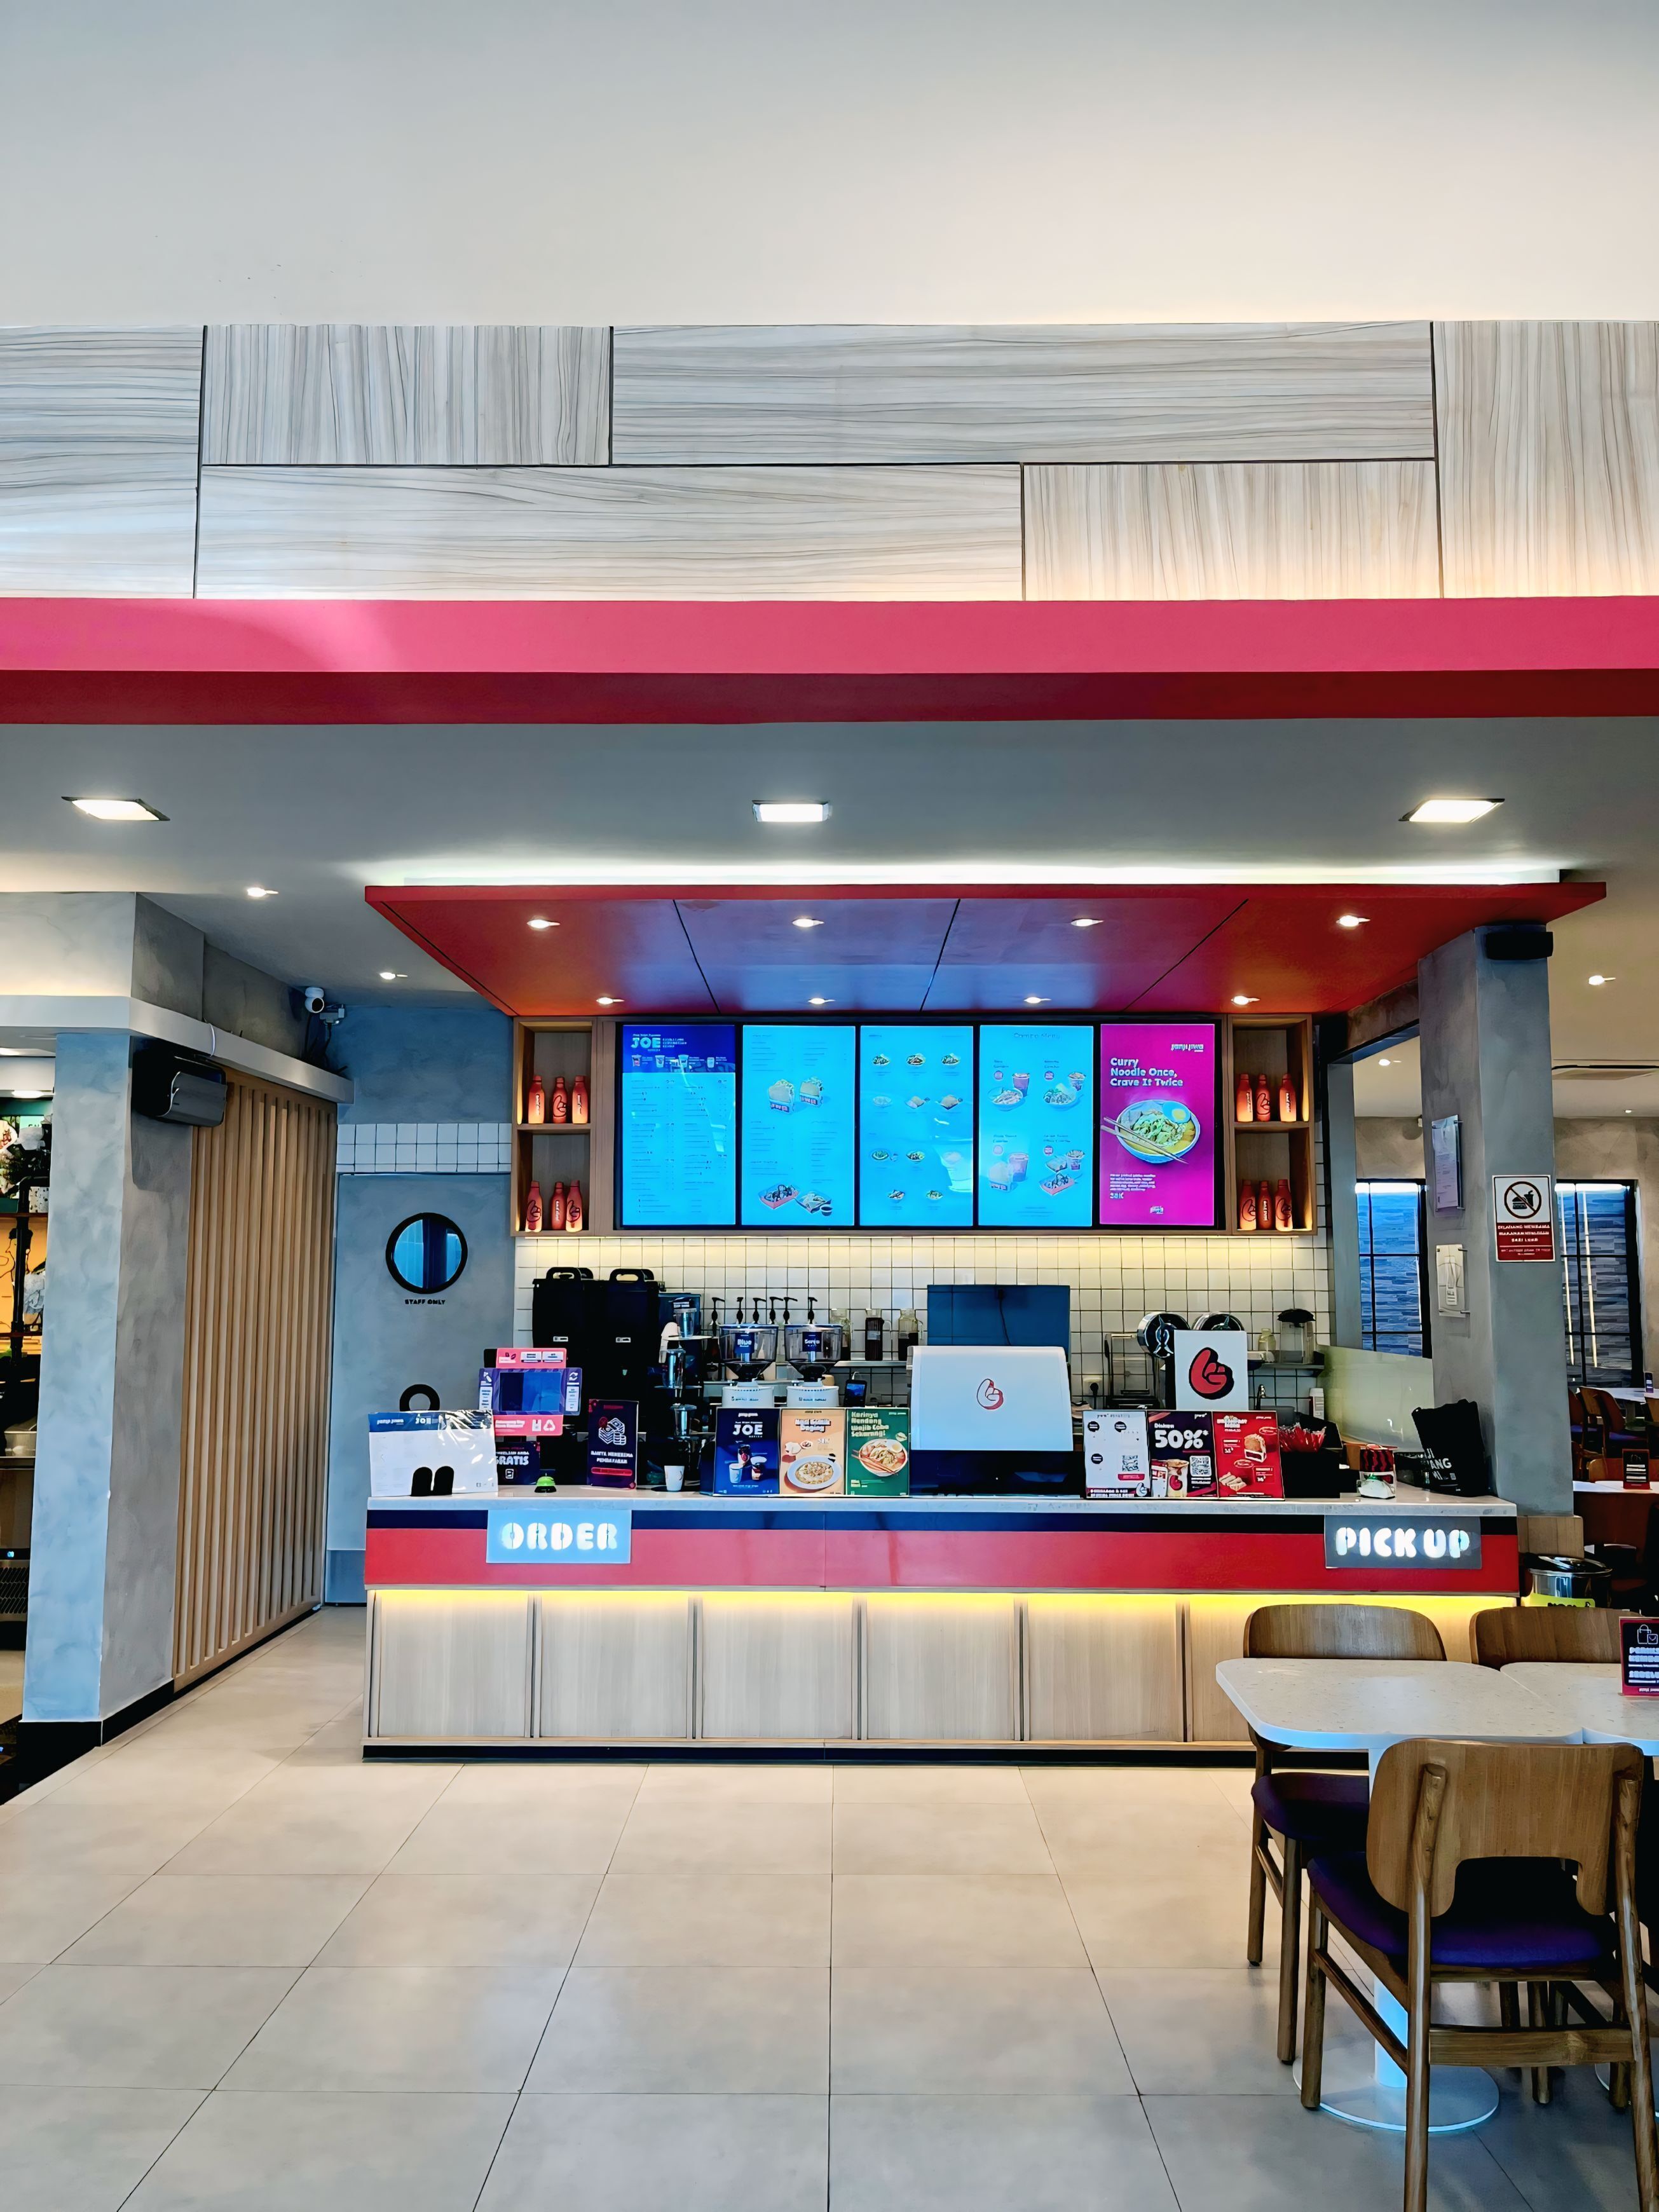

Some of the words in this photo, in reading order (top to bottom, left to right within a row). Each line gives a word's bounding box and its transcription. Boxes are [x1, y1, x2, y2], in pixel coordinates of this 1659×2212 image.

[631, 1037, 661, 1048] JOE
[1110, 1058, 1138, 1068] Curry
[1110, 1068, 1146, 1076] Noodle
[1149, 1068, 1177, 1077] Once,
[1110, 1078, 1139, 1086] Crave
[1156, 1077, 1184, 1086] Twice
[732, 1424, 763, 1435] JOE
[501, 1522, 618, 1551] ORDER
[1335, 1527, 1417, 1558] PICK
[1423, 1529, 1470, 1559] UP
